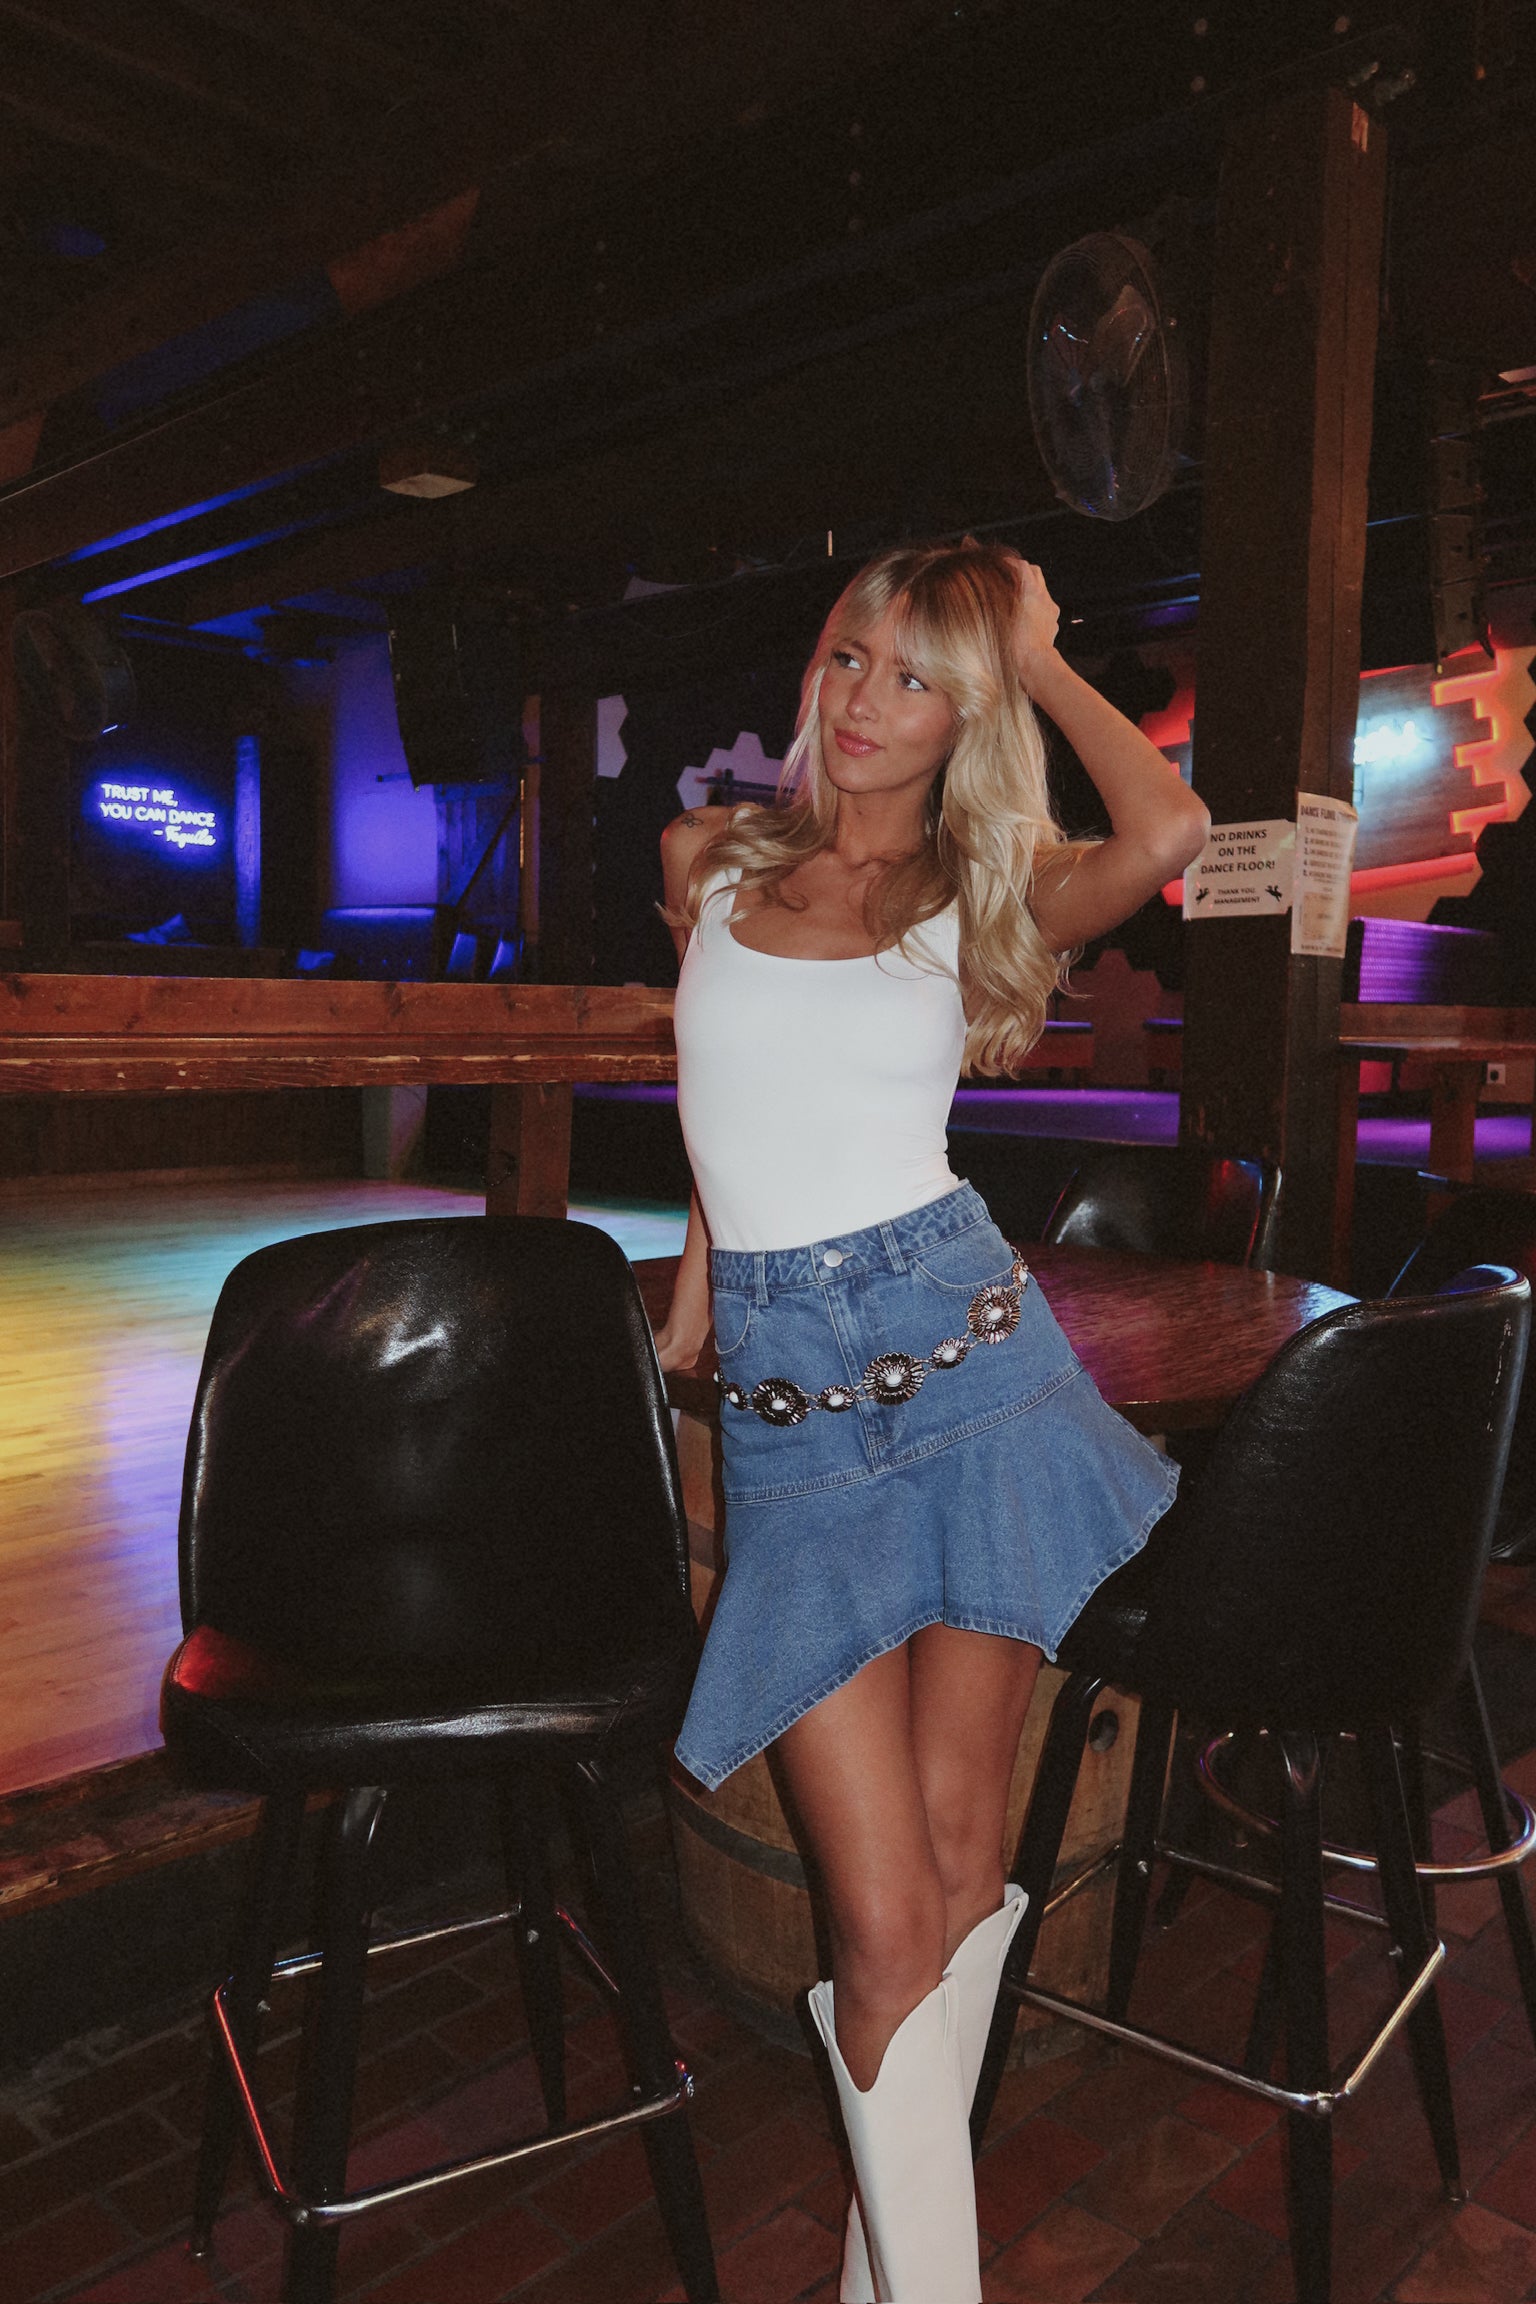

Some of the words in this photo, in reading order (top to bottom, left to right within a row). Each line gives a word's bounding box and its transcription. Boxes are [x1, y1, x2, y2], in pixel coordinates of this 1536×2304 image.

[101, 783, 150, 802] TRUST
[152, 789, 178, 807] ME,
[100, 802, 132, 819] YOU
[134, 806, 167, 822] CAN
[168, 809, 216, 827] DANCE
[1210, 833, 1226, 842] NO
[1228, 829, 1267, 840] DRINKS
[1218, 848, 1234, 857] ON
[1237, 845, 1256, 855] THE
[1201, 862, 1234, 874] DANCE
[1237, 861, 1275, 871] FLOOR!
[1214, 897, 1260, 905] MANAGEMENT
